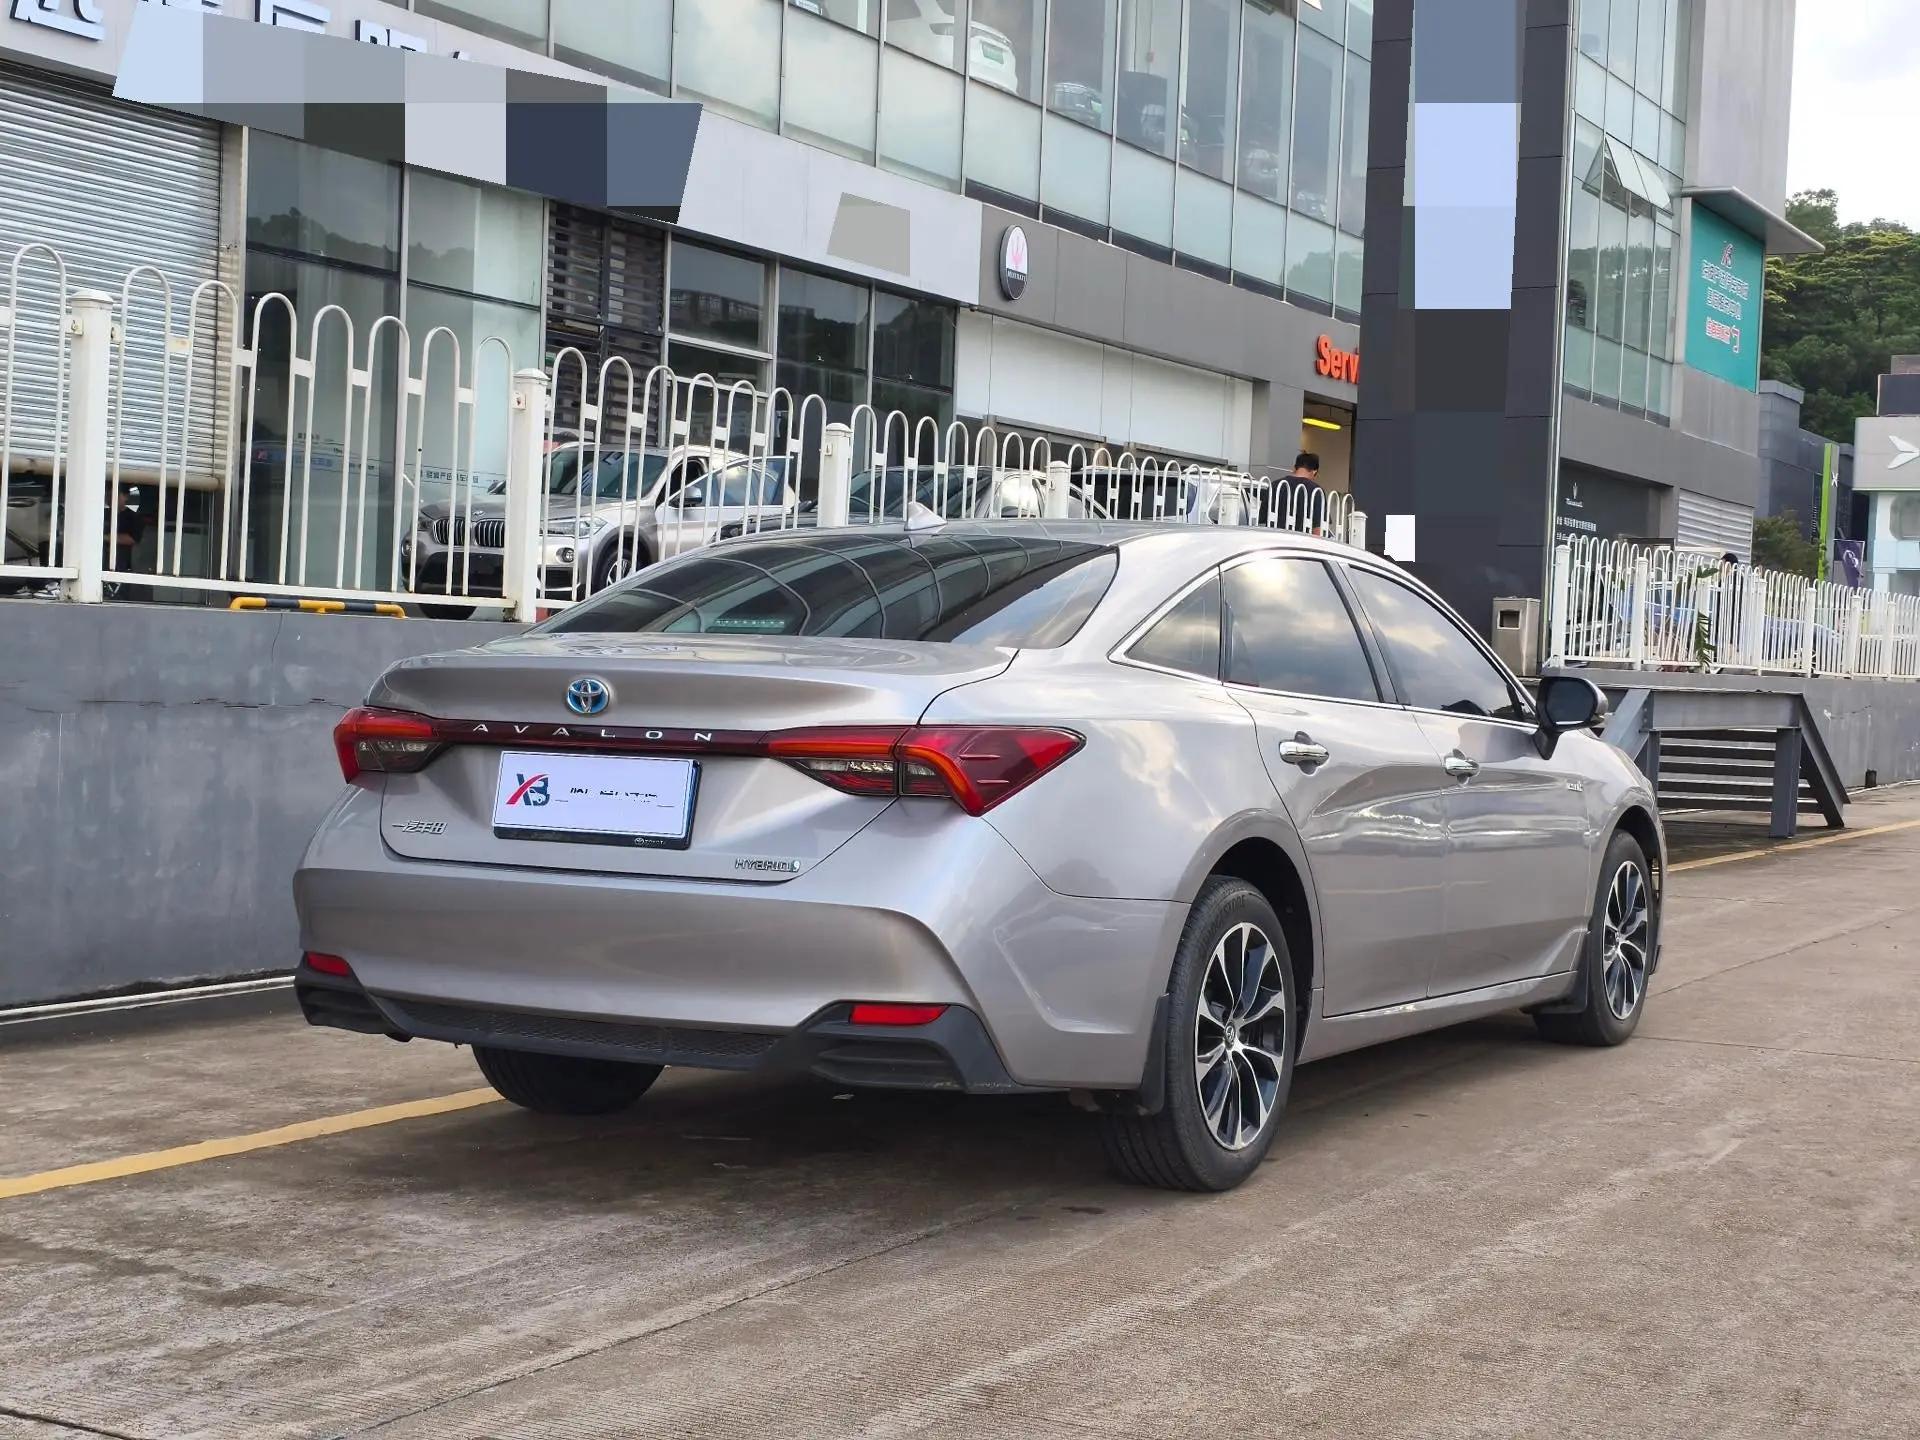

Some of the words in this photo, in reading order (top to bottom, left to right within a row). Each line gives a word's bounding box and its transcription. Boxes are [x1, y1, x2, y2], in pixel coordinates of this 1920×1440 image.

[1317, 334, 1360, 384] Serv
[473, 723, 712, 742] AVALON
[391, 820, 448, 835] 一汽丰田
[735, 858, 790, 872] HYBRID
